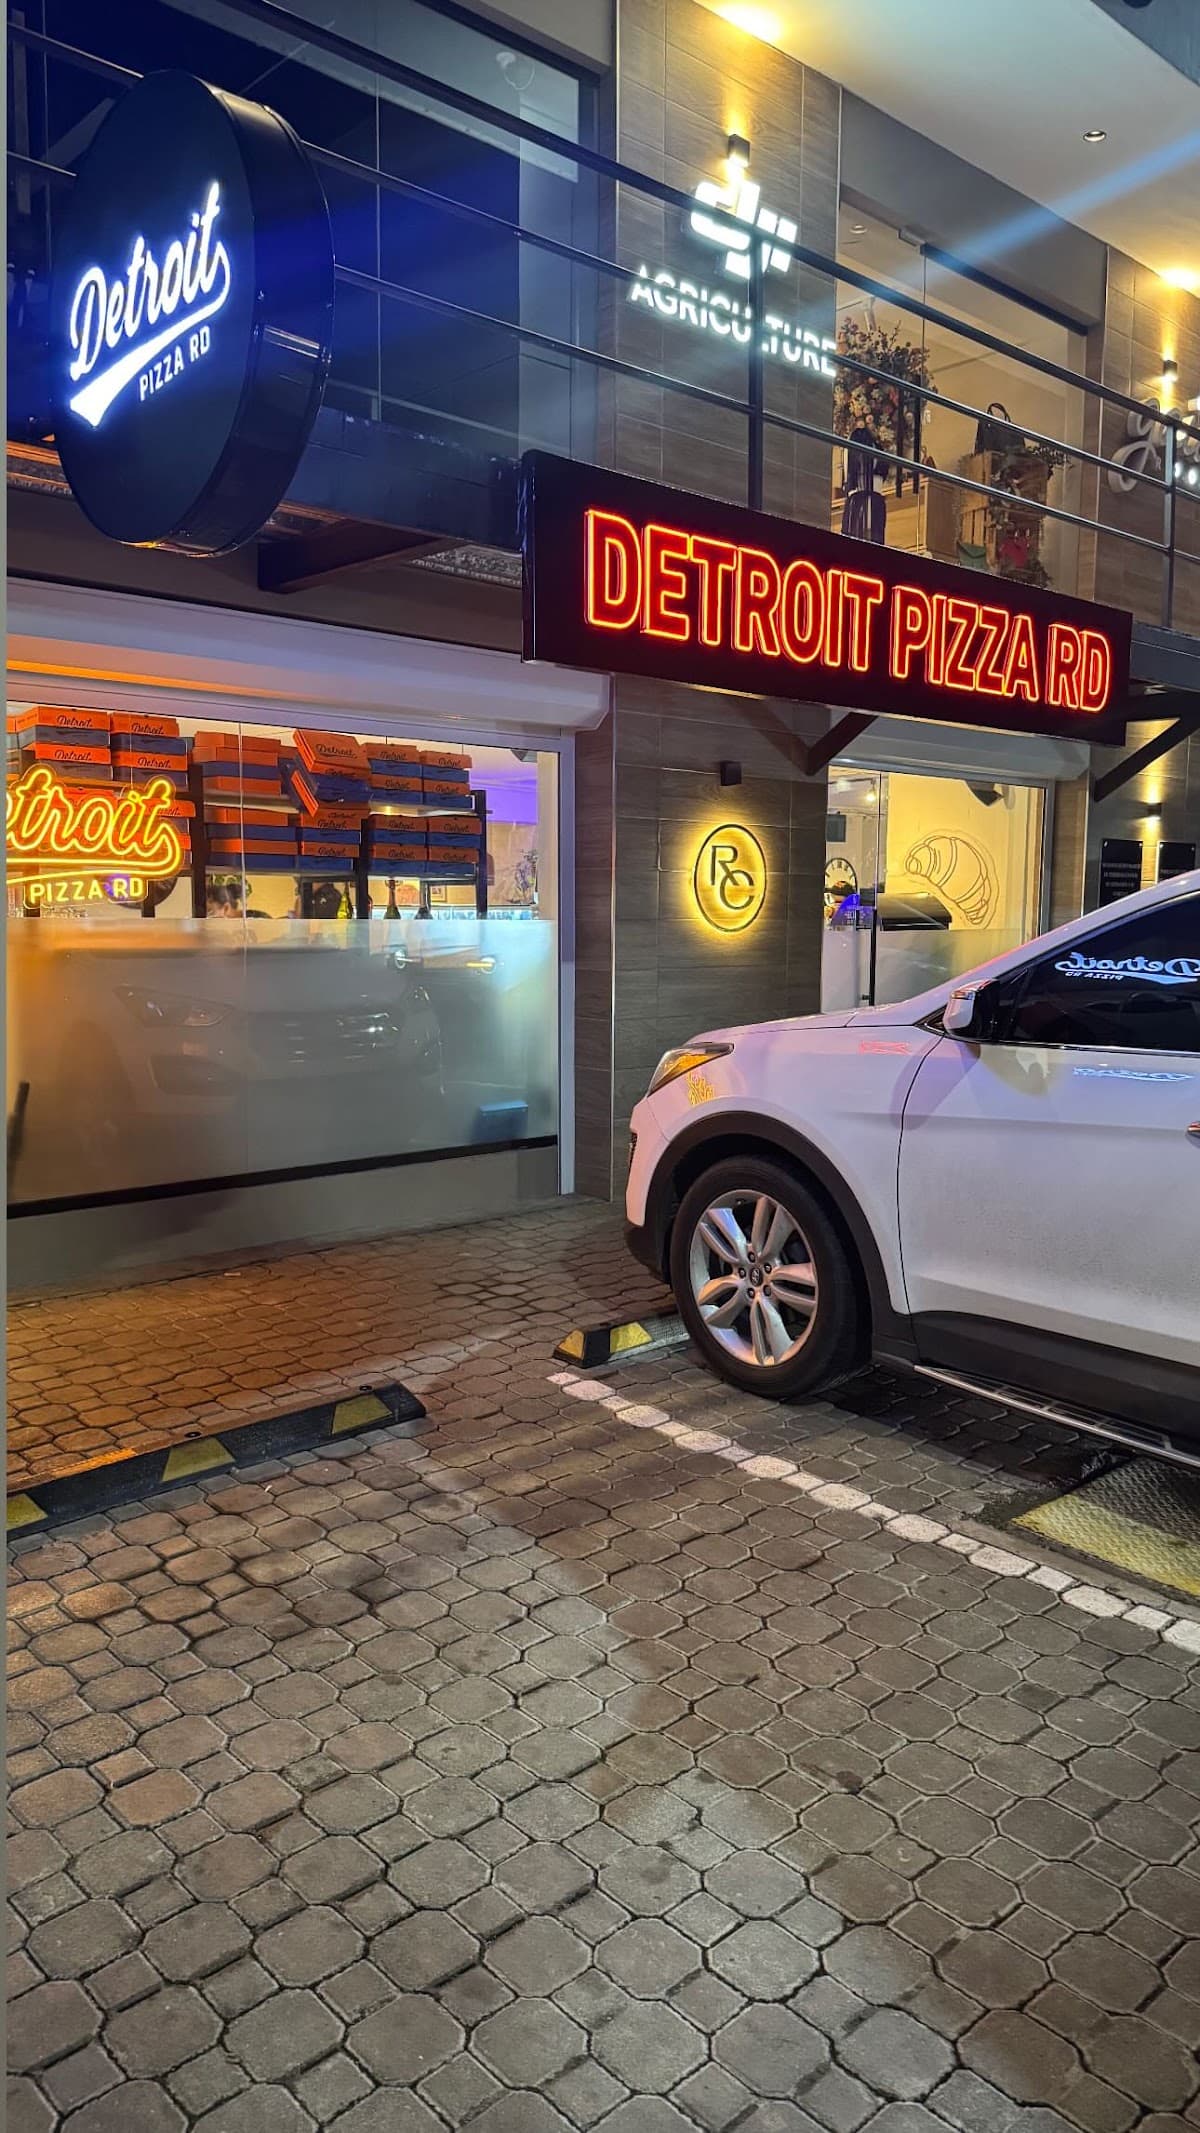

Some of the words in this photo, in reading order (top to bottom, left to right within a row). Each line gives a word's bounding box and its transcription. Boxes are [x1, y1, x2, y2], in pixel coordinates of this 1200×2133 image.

[70, 181, 230, 382] Detroit
[630, 264, 837, 377] AGRICUTURE
[139, 345, 184, 402] PIZZA
[189, 325, 211, 363] RD
[585, 508, 884, 673] DETROIT
[890, 584, 1040, 702] PIZZA
[1045, 622, 1111, 713] RD
[6, 768, 182, 858] troit
[29, 879, 103, 904] PIZZA
[113, 877, 144, 899] RD
[710, 845, 755, 910] RC
